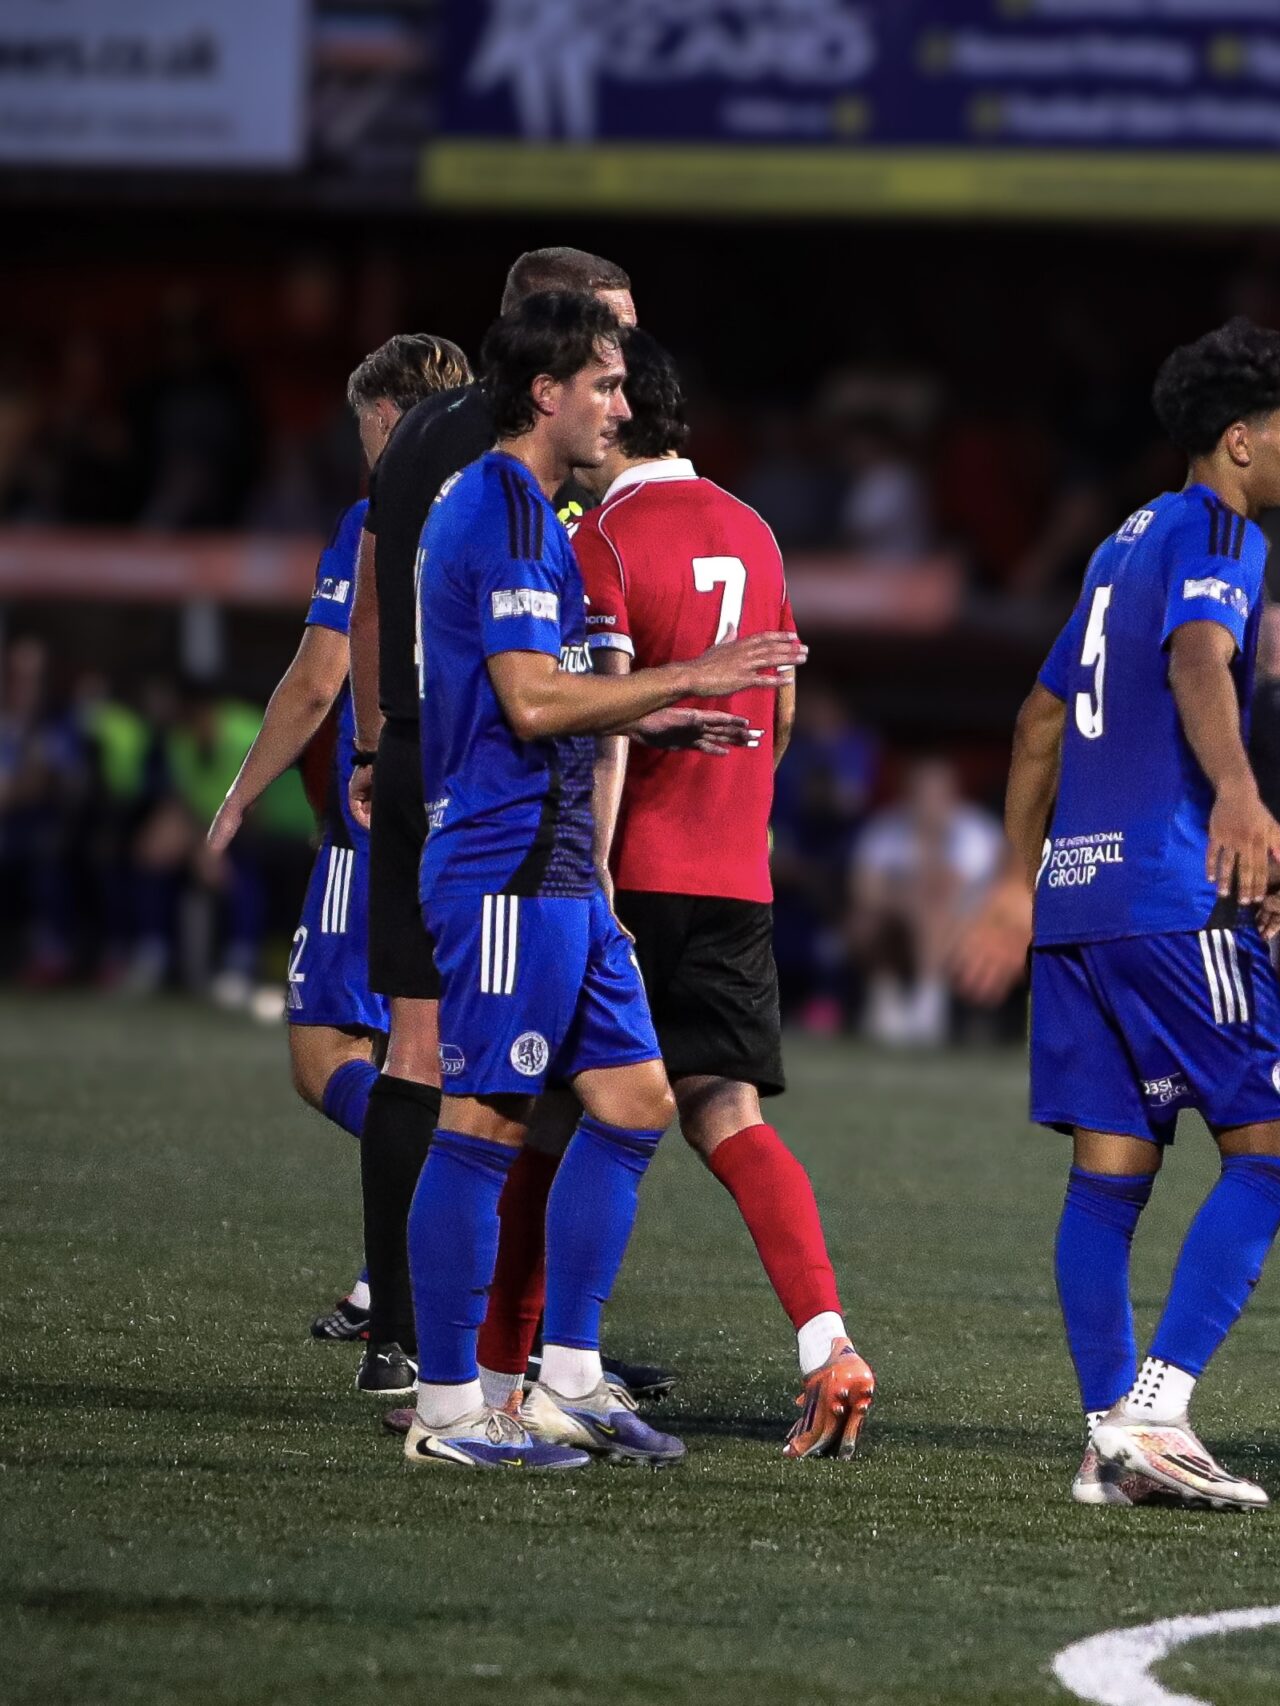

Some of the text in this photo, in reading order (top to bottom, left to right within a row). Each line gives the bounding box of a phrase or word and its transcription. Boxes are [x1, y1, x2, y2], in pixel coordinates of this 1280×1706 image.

[692, 556, 748, 648] 7
[1075, 584, 1114, 739] 5
[1048, 865, 1097, 888] GROUP
[1050, 843, 1124, 869] FOOTBALL
